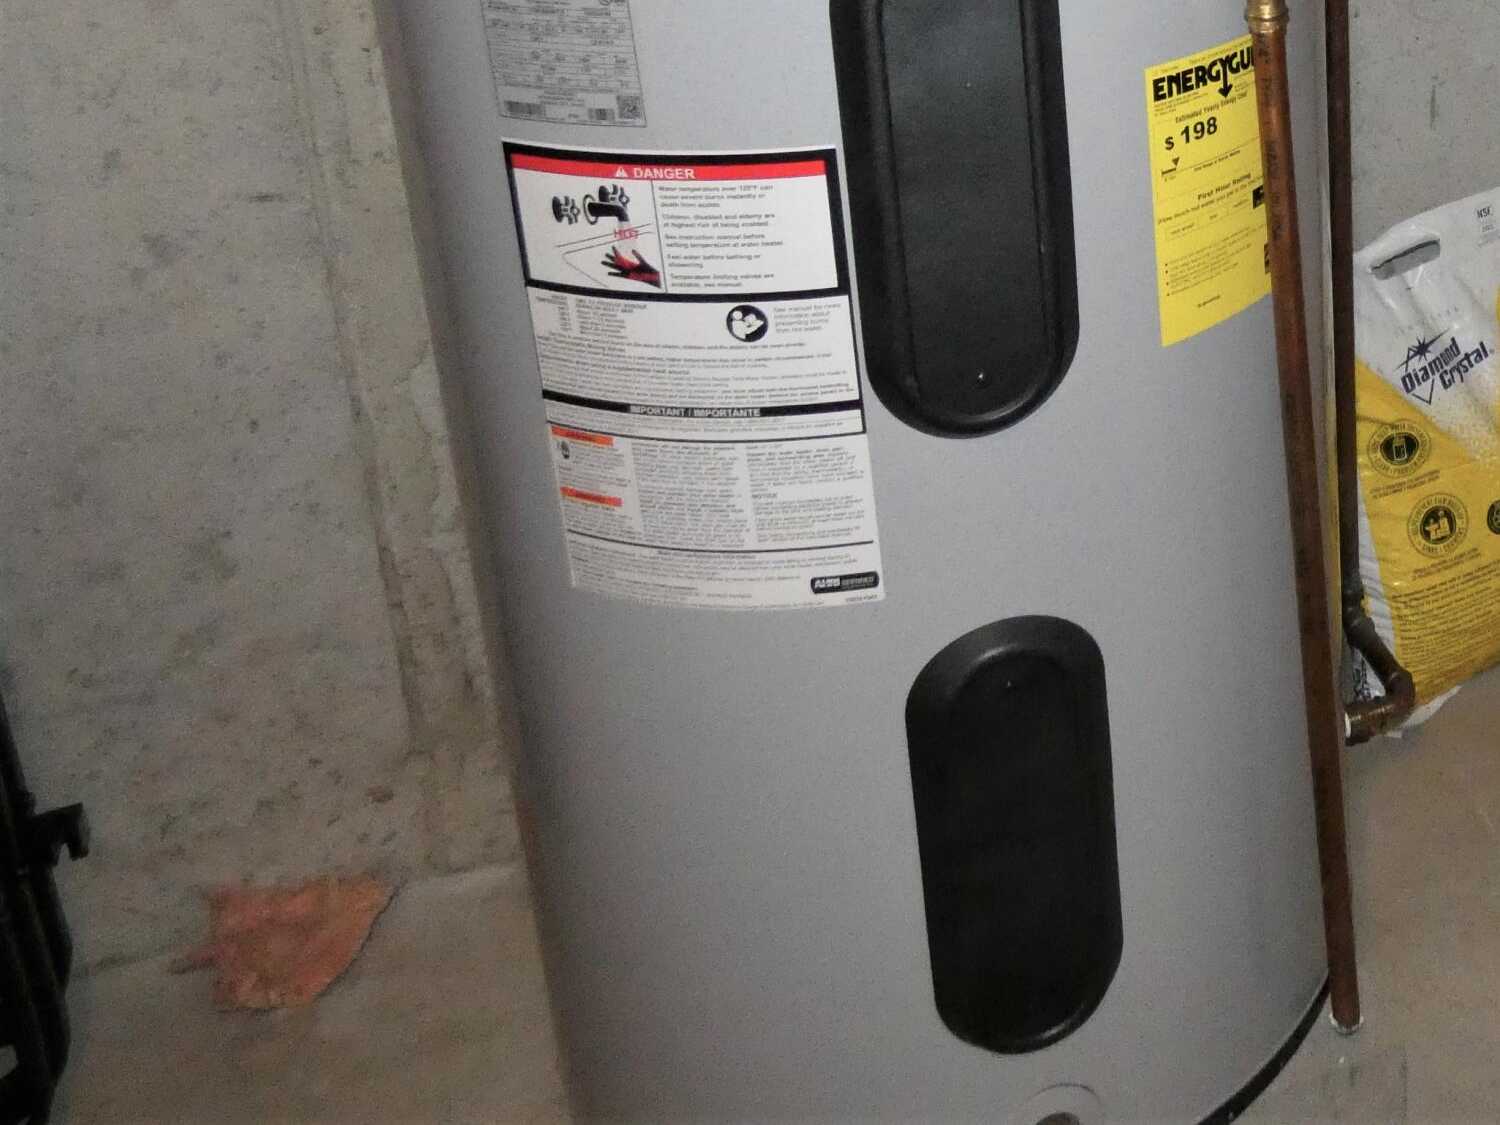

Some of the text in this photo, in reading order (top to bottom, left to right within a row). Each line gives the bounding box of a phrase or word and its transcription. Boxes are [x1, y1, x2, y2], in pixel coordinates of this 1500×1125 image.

[1176, 107, 1202, 123] Estimated
[1203, 102, 1219, 116] Yearly
[1221, 95, 1237, 107] Energy
[1165, 116, 1218, 151] $ 198
[633, 167, 695, 180] DANGER
[1197, 172, 1252, 201] First Hour Rating
[1400, 337, 1461, 394] Diamond
[1439, 341, 1489, 391] Crystal
[630, 406, 685, 416] IMPORTANT
[693, 408, 761, 417] IMPORTANTE
